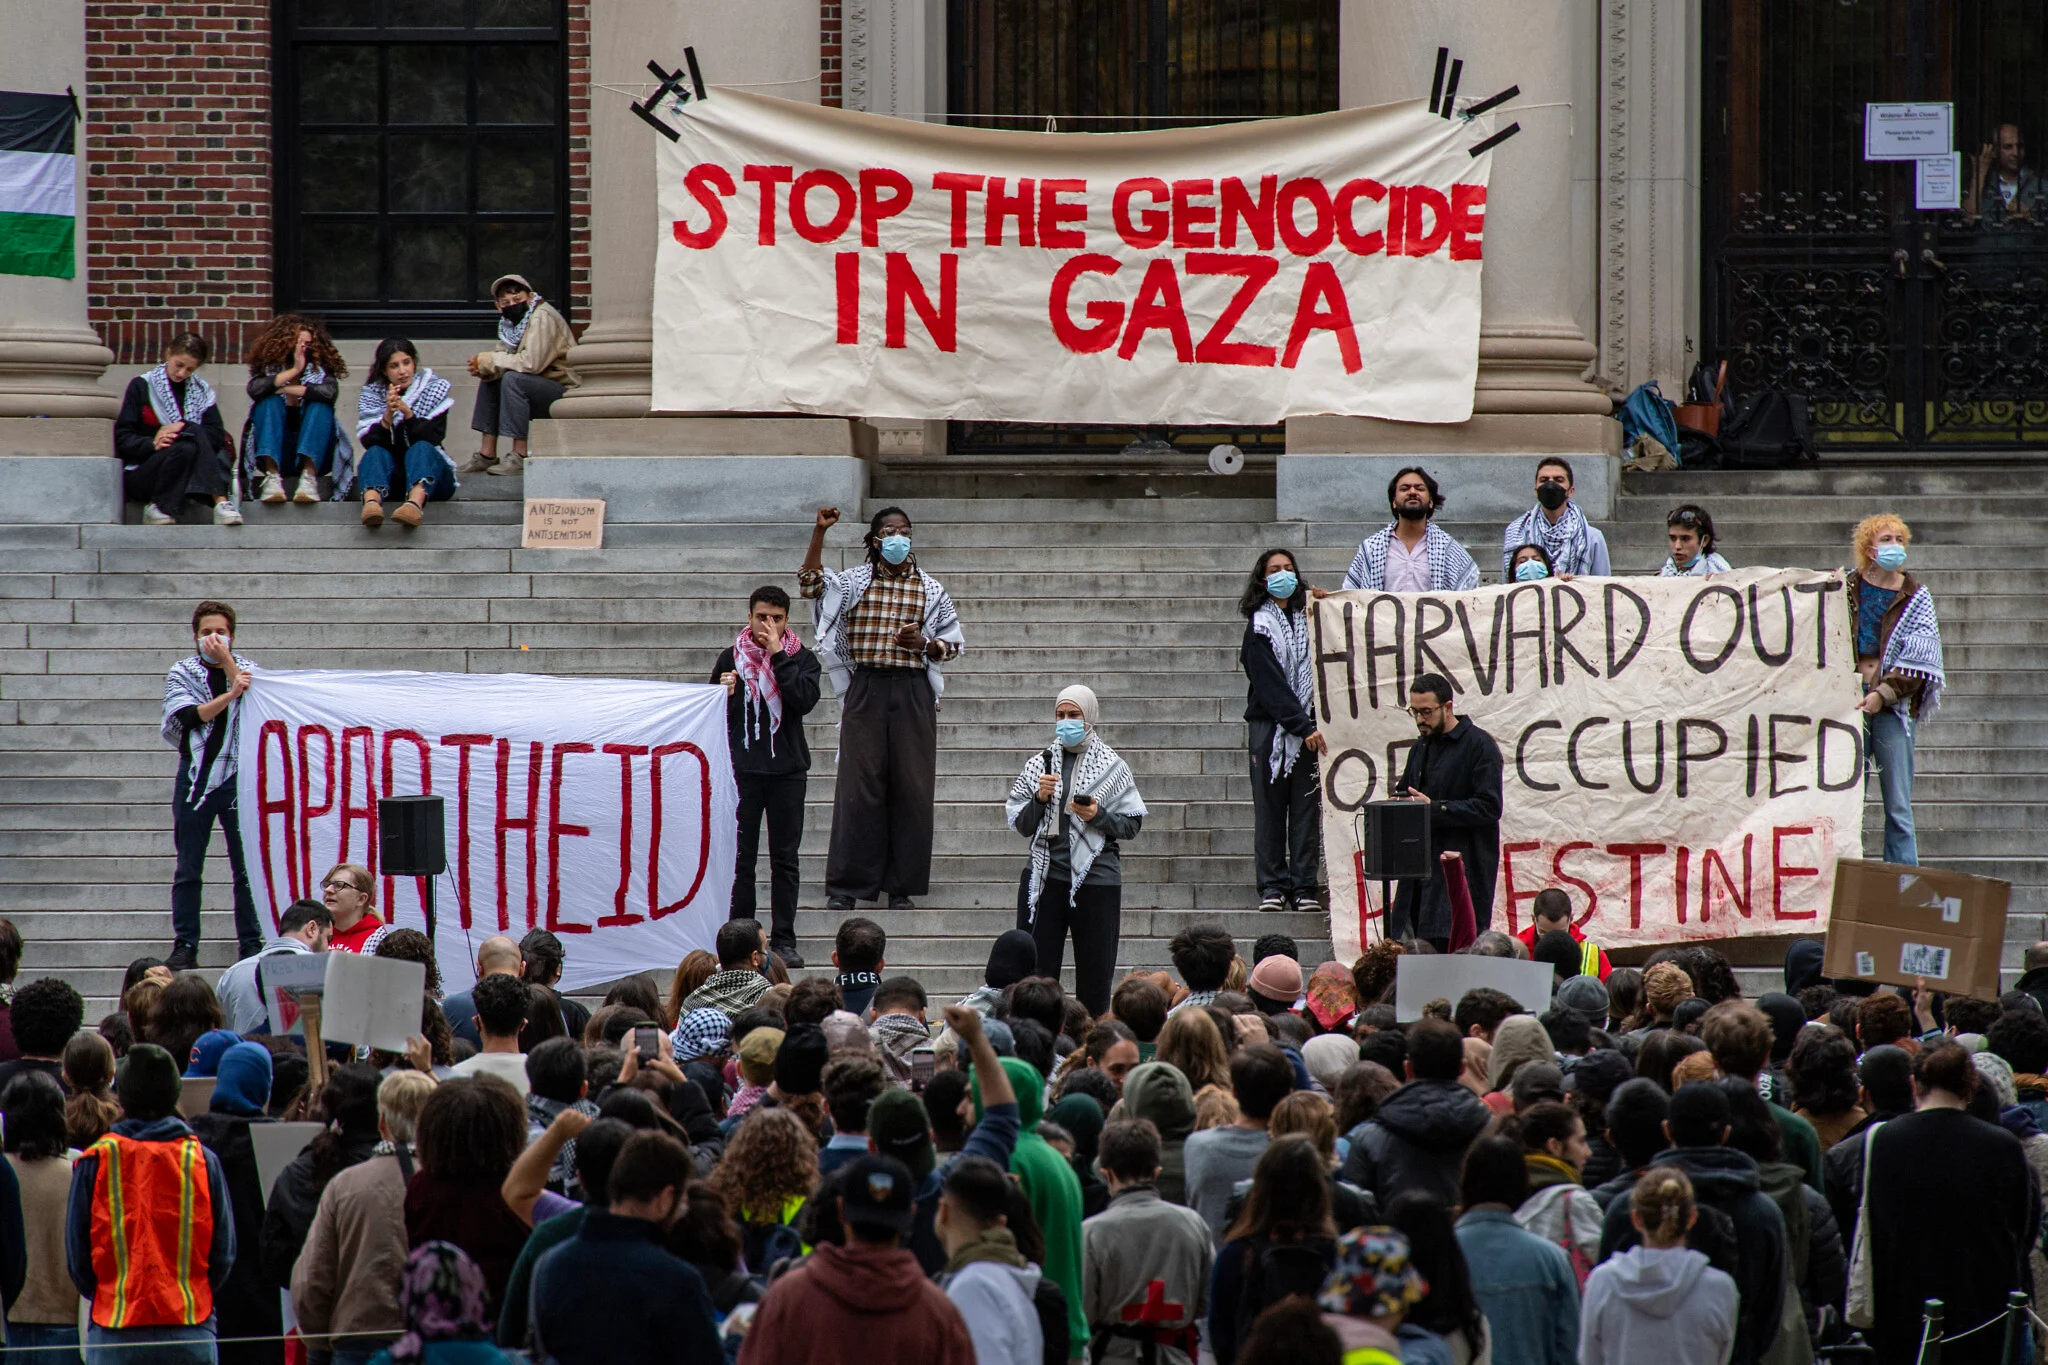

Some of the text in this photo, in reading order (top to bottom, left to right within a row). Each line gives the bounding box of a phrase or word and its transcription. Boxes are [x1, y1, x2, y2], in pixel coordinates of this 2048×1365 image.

[672, 163, 1488, 262] STOP THE GENOCIDE
[835, 251, 1364, 376] IN GAZA
[528, 530, 592, 540] ANTISEMITISM
[530, 504, 594, 516] ANTIZIONISM
[1313, 580, 1844, 724] HARVARD OUT
[1515, 712, 1864, 799] CCUPIED
[257, 719, 713, 935] APARTHEID
[833, 972, 879, 985] FIGE
[189, 1046, 201, 1064] C
